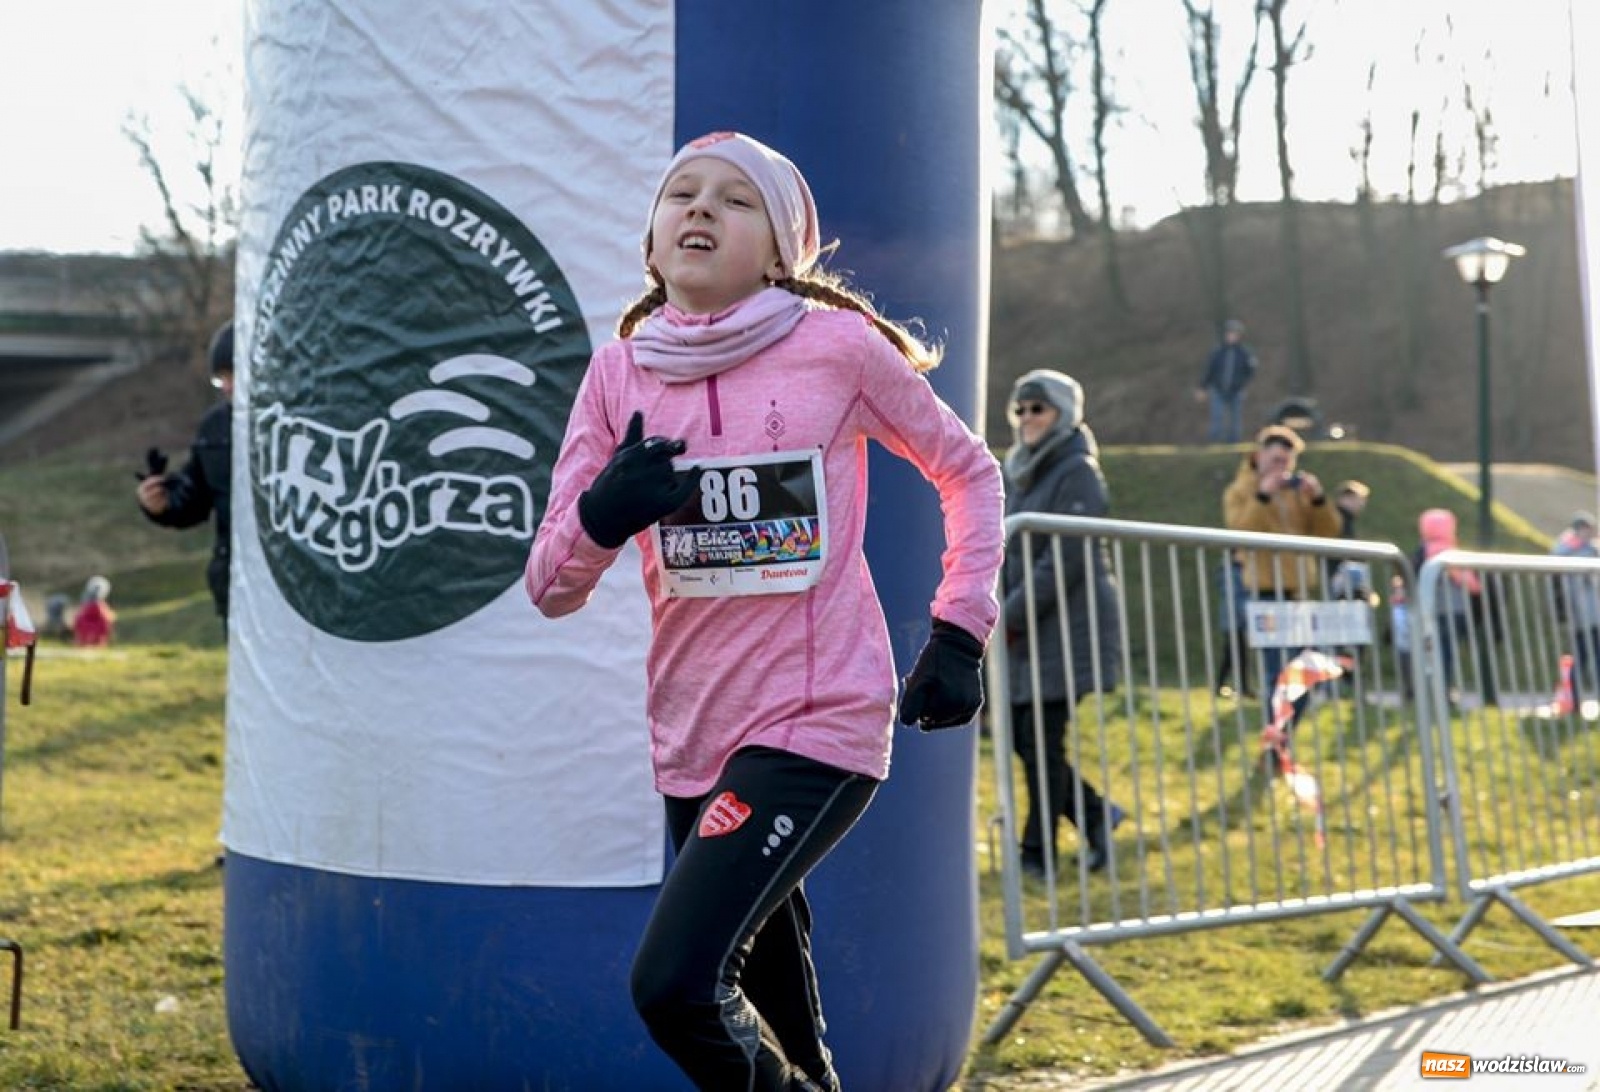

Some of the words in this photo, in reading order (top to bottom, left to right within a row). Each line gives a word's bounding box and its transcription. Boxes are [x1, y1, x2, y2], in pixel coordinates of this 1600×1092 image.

[327, 184, 403, 224] PARK
[407, 188, 563, 334] ROZRYWKI
[700, 467, 761, 523] 86
